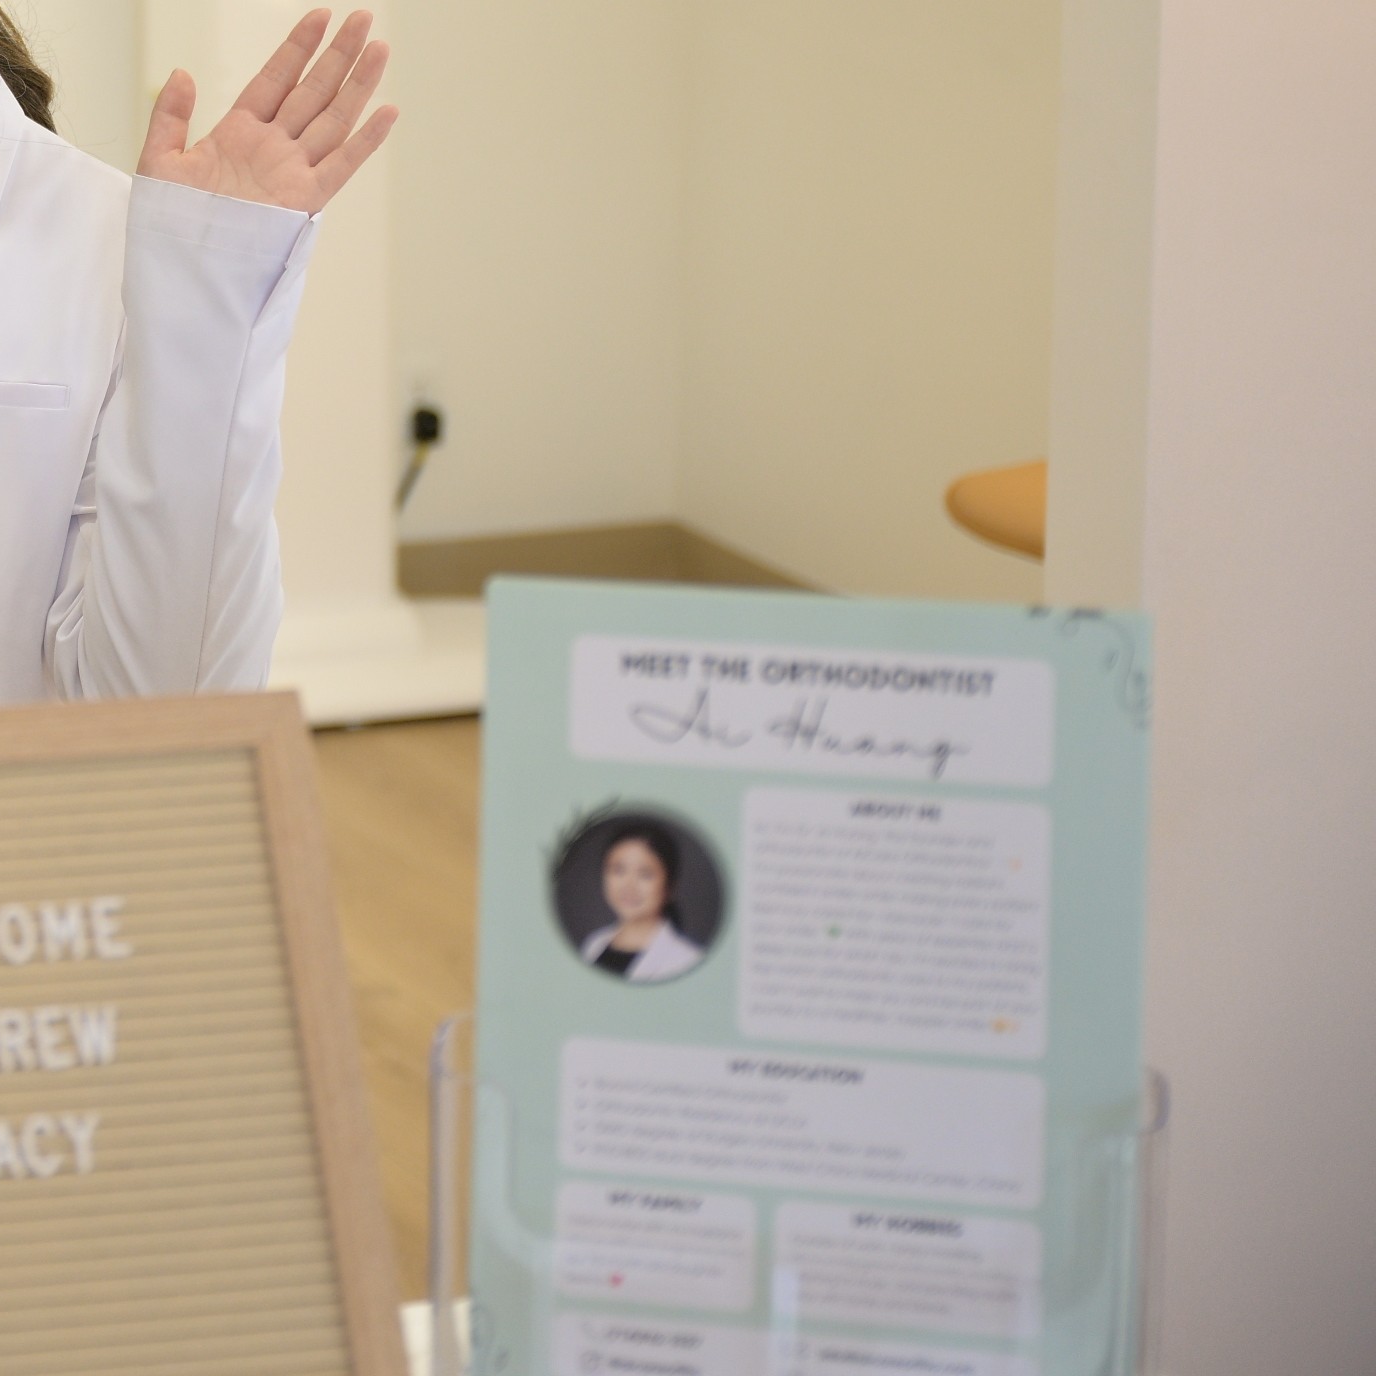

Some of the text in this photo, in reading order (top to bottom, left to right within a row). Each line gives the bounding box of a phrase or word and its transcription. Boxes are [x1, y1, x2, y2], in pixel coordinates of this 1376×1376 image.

[620, 652, 996, 697] MEET THE ORTHODONTIST
